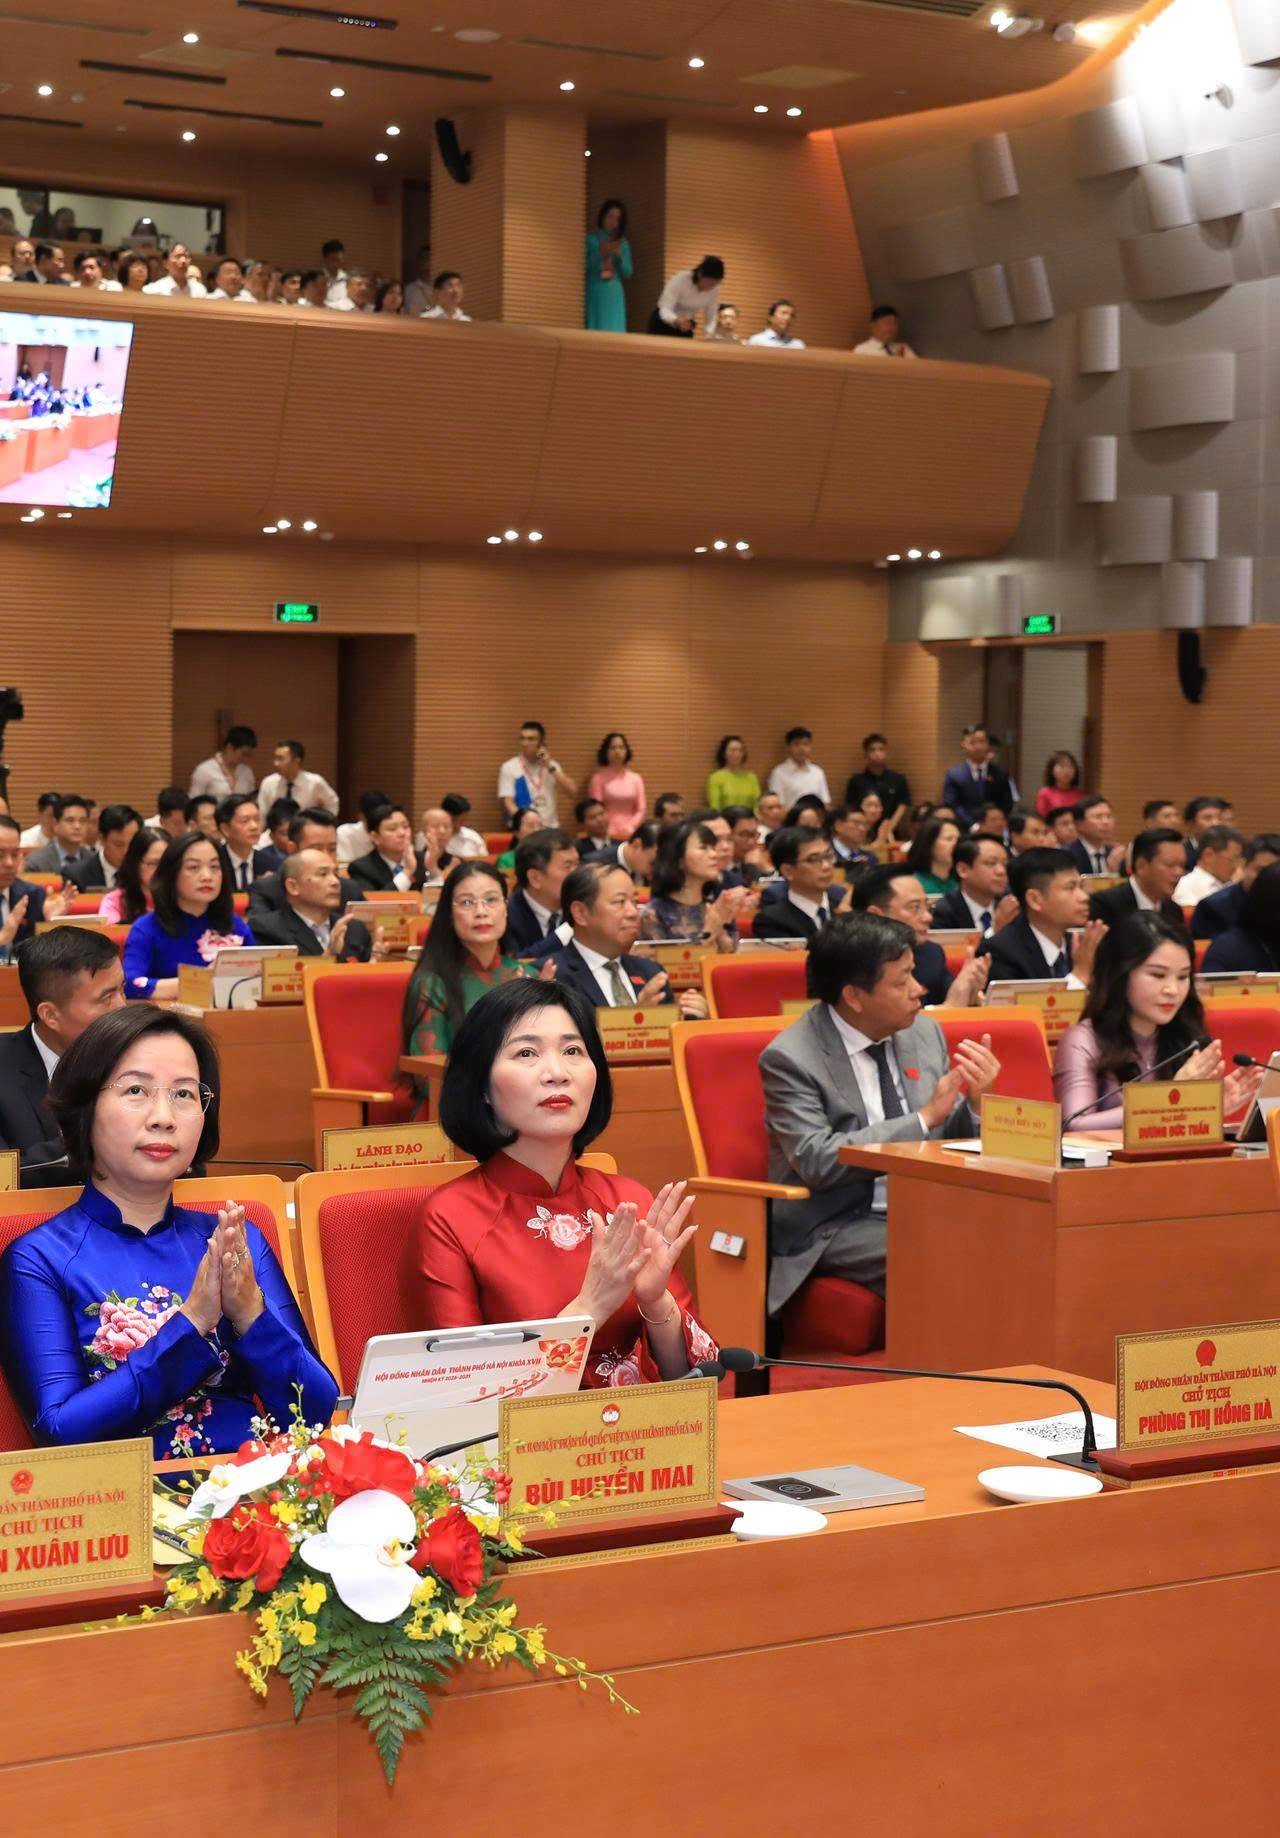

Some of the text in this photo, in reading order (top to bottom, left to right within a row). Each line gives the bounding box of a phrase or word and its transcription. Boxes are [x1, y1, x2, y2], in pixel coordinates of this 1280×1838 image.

[356, 1143, 423, 1157] LÃNH ĐẠO
[375, 1370, 388, 1382] HỘI
[389, 1369, 410, 1381] ĐỒNG
[411, 1368, 430, 1378] NHÂN
[431, 1367, 447, 1377] DÂN
[449, 1363, 471, 1374] THÀNH
[471, 1361, 486, 1372] PHỐ
[487, 1360, 496, 1370] HÀ
[496, 1360, 508, 1370] NỘI
[1134, 1365, 1277, 1392] HỘI ĐỒNG NHÂN DÂN THÀNH PHỐ HÀ NỘI
[1182, 1385, 1231, 1402] CHỦ TỊCH
[1138, 1398, 1273, 1434] PHÙNG THỊ HỒNG HÀ
[575, 1447, 646, 1468] CHỦ TỊCH
[525, 1463, 693, 1506] BÙI HUYỀN MAI
[20, 1497, 61, 1513] THÀNH
[62, 1490, 86, 1508] PHỐ
[87, 1489, 102, 1505] HÀ
[104, 1487, 125, 1503] NỘI
[0, 1515, 36, 1536] CHỦ
[42, 1514, 83, 1535] TỊCH
[15, 1538, 79, 1572] XUÂN
[87, 1533, 129, 1562] LƯU
